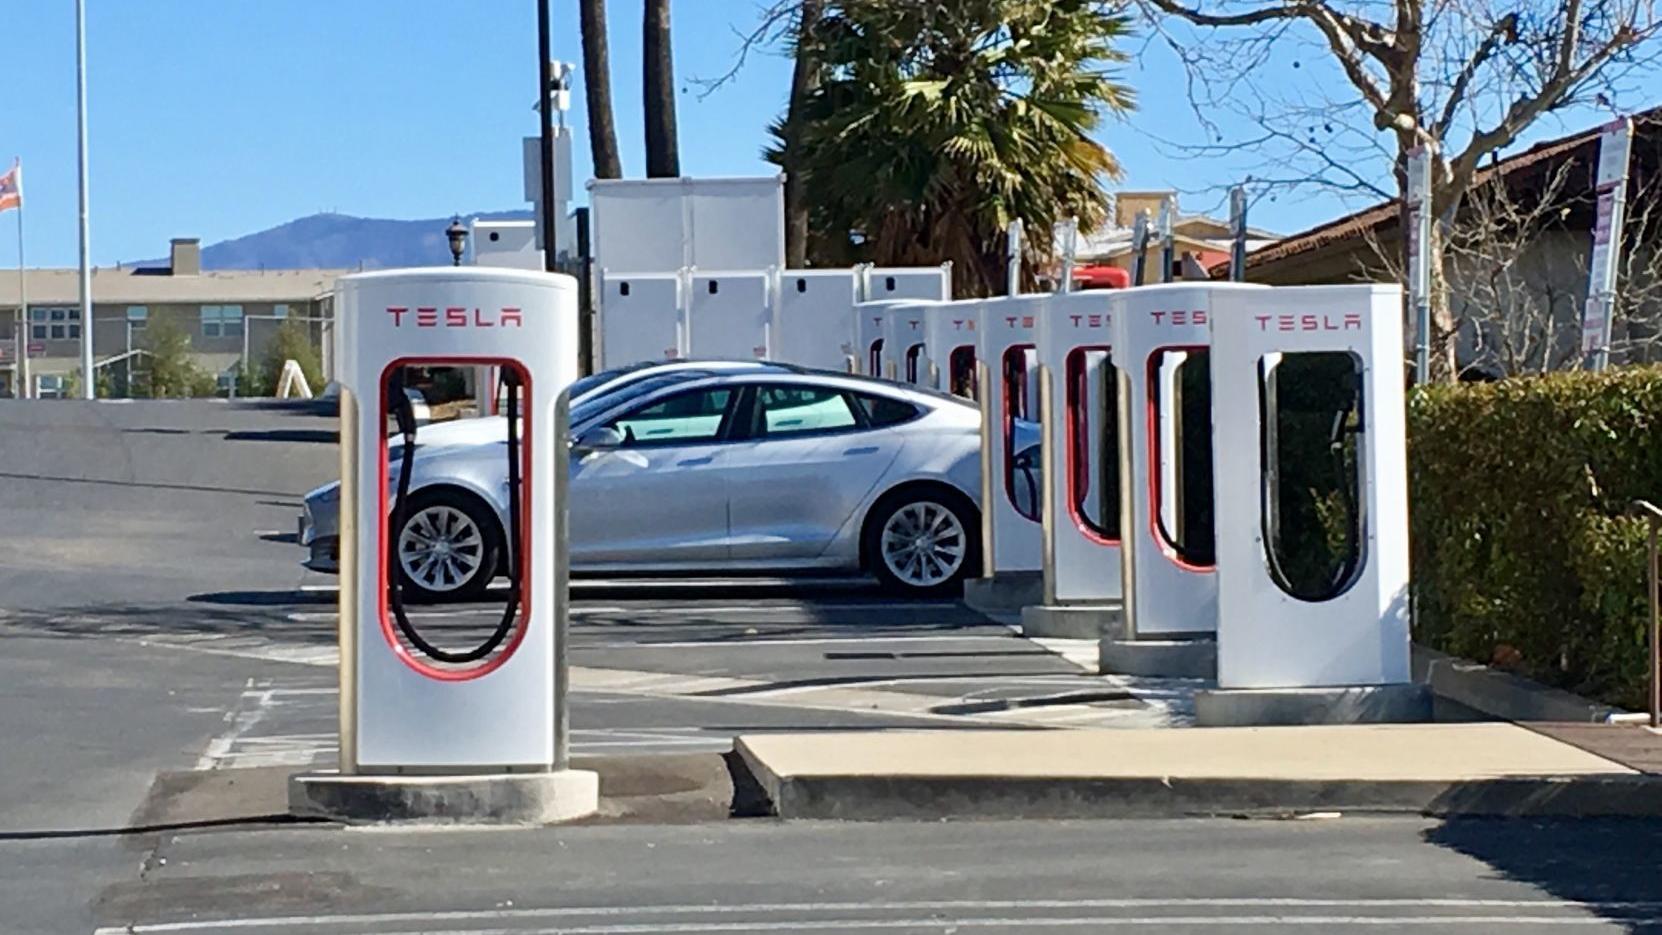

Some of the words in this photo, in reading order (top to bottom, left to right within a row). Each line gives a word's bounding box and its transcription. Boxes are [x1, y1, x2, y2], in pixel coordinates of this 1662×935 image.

[386, 308, 522, 327] TESLA
[1150, 310, 1207, 325] TES
[1254, 314, 1361, 331] TESLA
